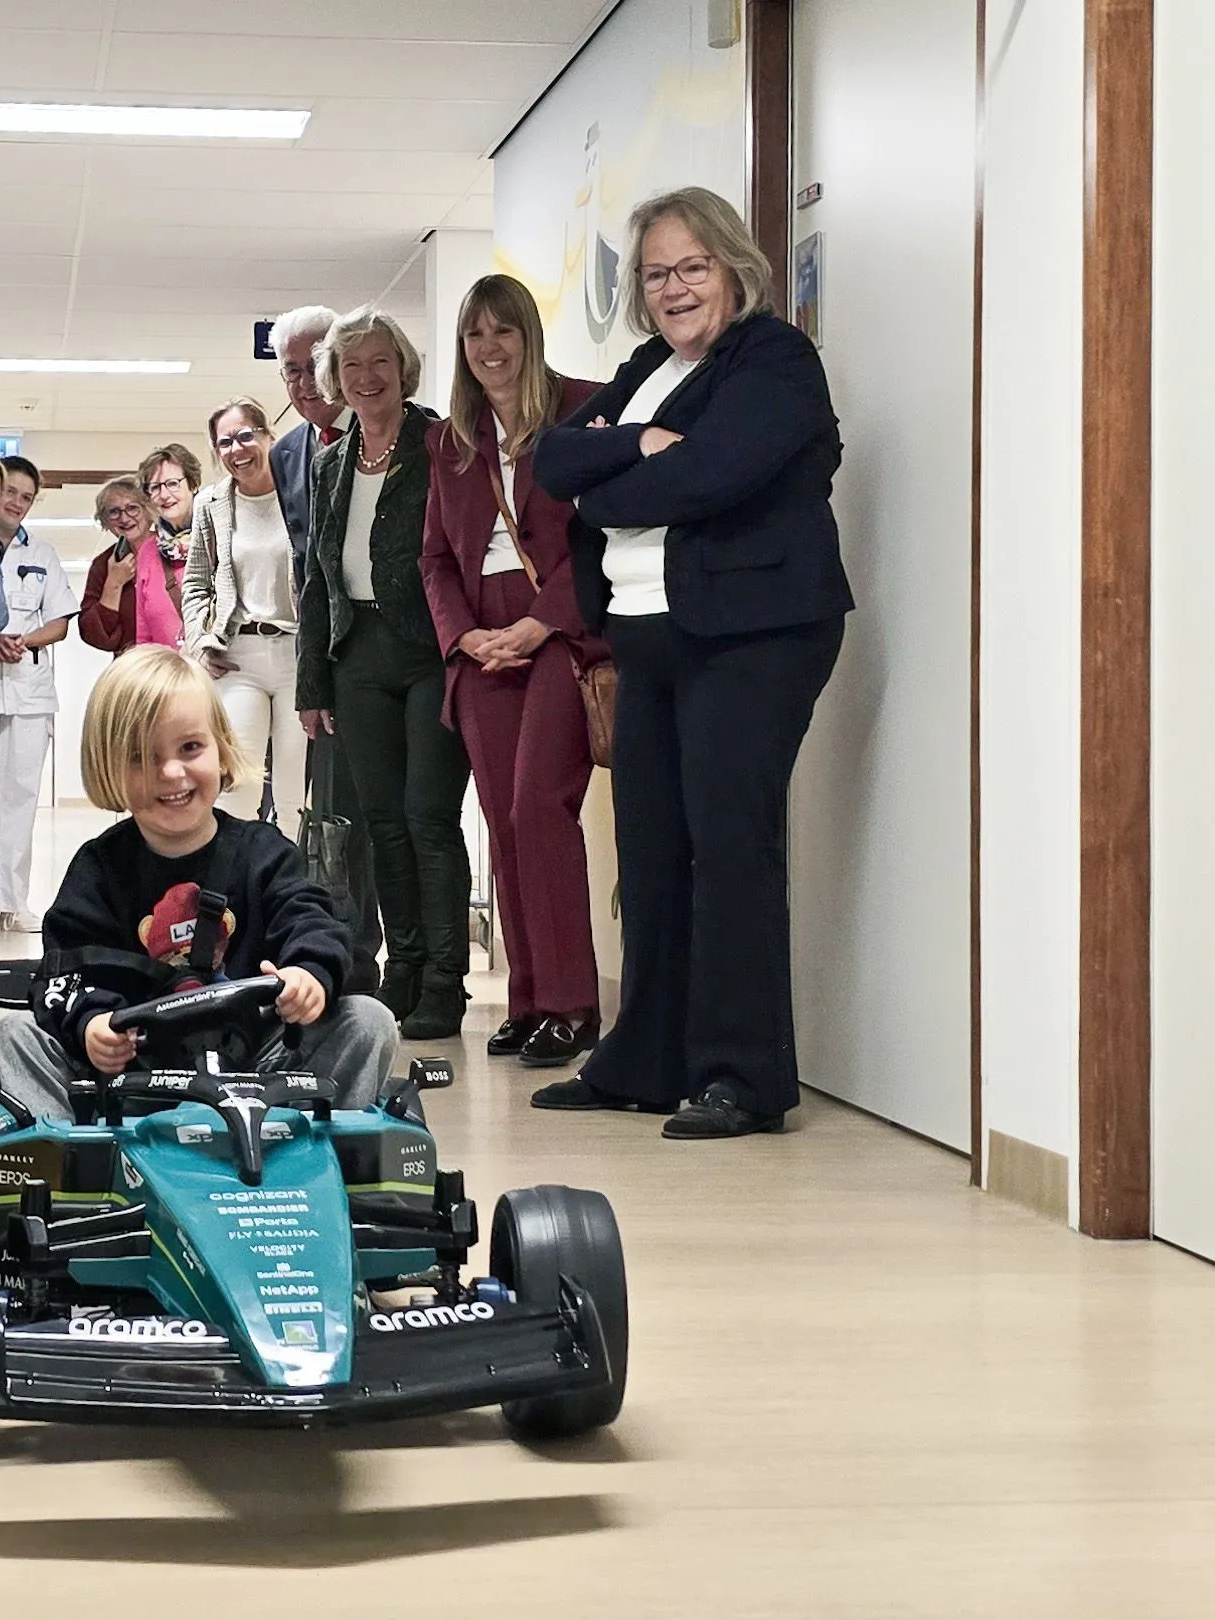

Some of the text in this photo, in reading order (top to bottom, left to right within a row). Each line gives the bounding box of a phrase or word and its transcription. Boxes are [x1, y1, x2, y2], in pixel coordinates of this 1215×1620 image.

[426, 1071, 449, 1081] BOSS
[403, 1160, 426, 1177] EPOS
[209, 1189, 308, 1202] cognizant
[217, 1203, 310, 1215] BOMBARDIER
[260, 1285, 319, 1296] NetApp
[369, 1301, 495, 1332] aramco
[68, 1317, 208, 1338] aramco
